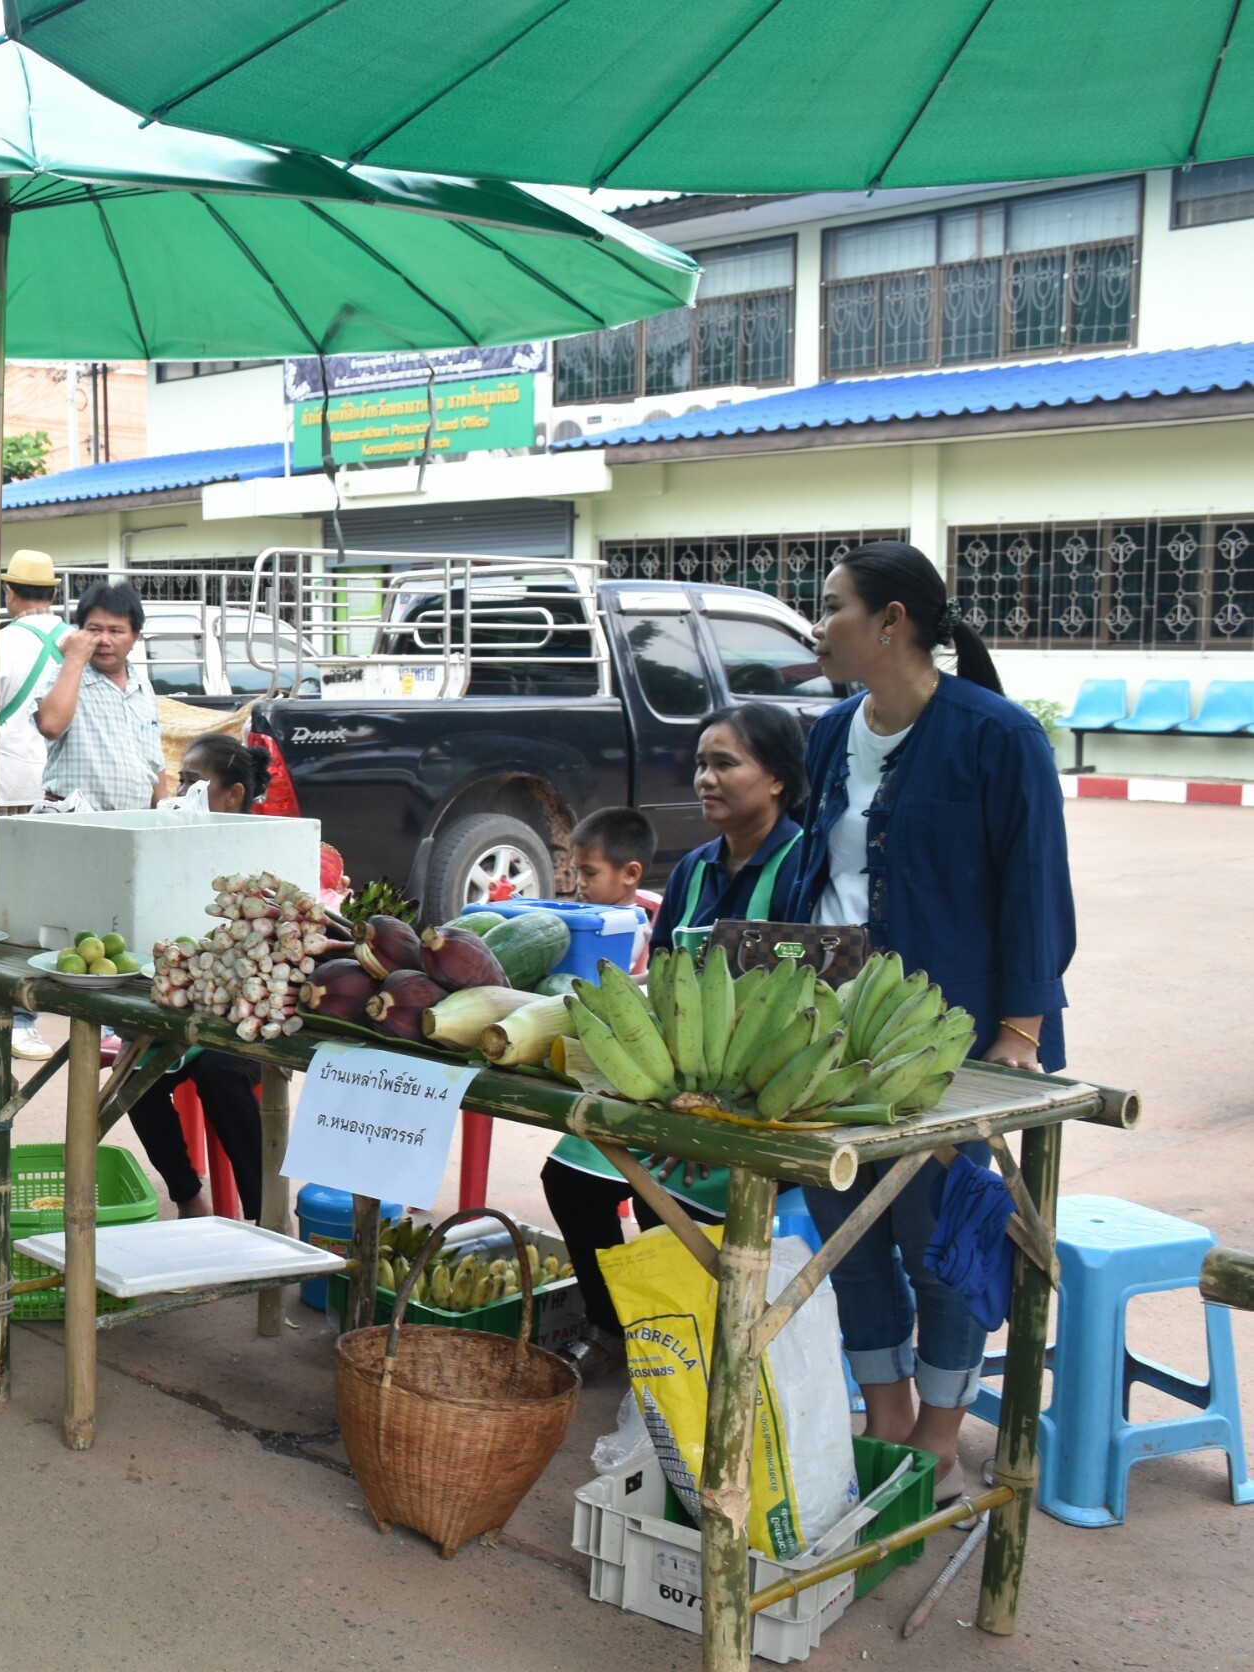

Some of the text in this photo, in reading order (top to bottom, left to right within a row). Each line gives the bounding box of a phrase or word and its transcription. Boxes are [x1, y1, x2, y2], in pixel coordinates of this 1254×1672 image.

[461, 415, 489, 430] Office
[320, 1061, 449, 1101] บ้านเหล่าโพธิ์ชัย ม.4
[317, 1112, 427, 1147] ต.หนองกุงสวรรค์
[659, 1583, 704, 1612] 607
